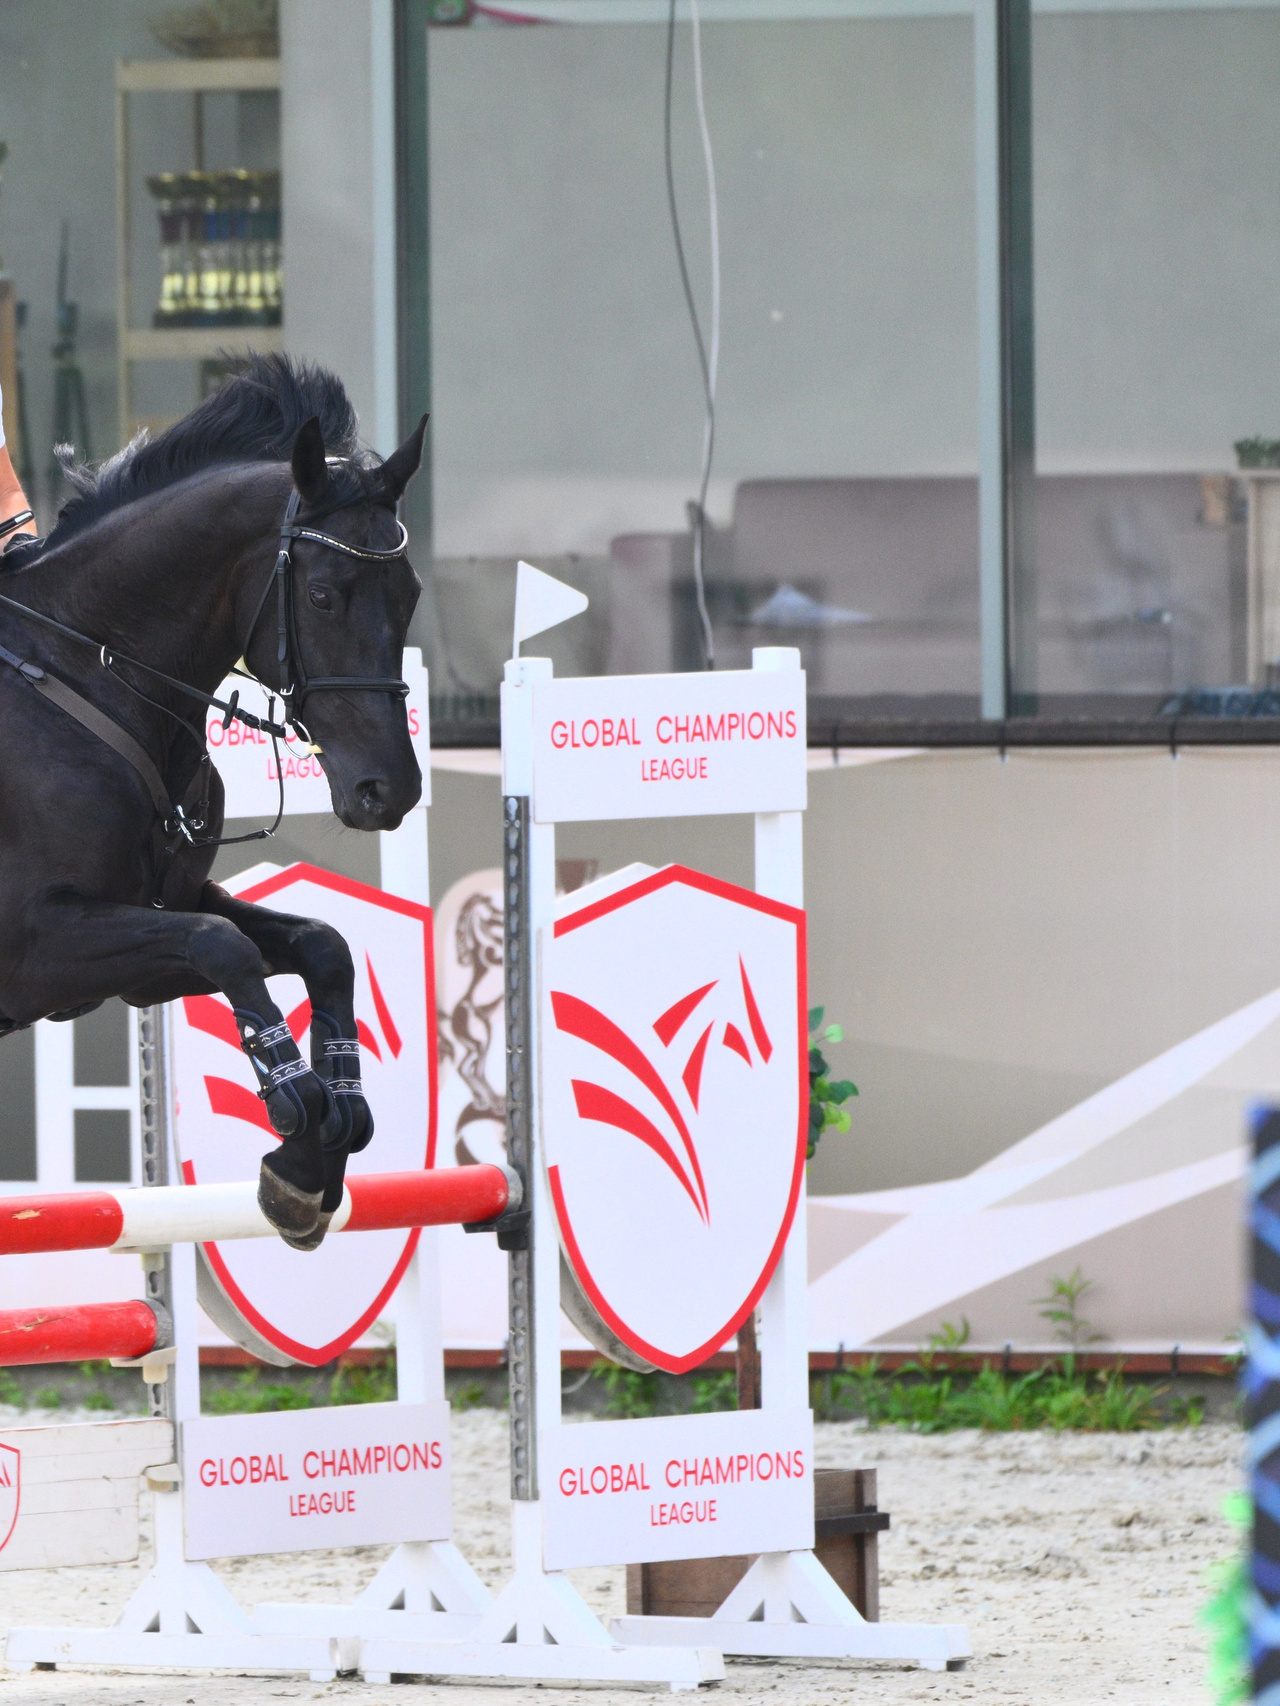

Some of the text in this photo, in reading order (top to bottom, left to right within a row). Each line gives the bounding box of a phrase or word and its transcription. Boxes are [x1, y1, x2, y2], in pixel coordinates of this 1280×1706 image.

[208, 718, 267, 747] OBAL
[551, 710, 797, 749] GLOBAL CHAMPIONS
[268, 757, 323, 780] LEAGU
[642, 757, 708, 781] LEAGUE
[200, 1441, 442, 1487] GLOBAL CHAMPIONS
[559, 1449, 805, 1497] GLOBAL CHAMPIONS
[290, 1490, 356, 1517] LEAGUE
[651, 1500, 717, 1526] LEAGUE
